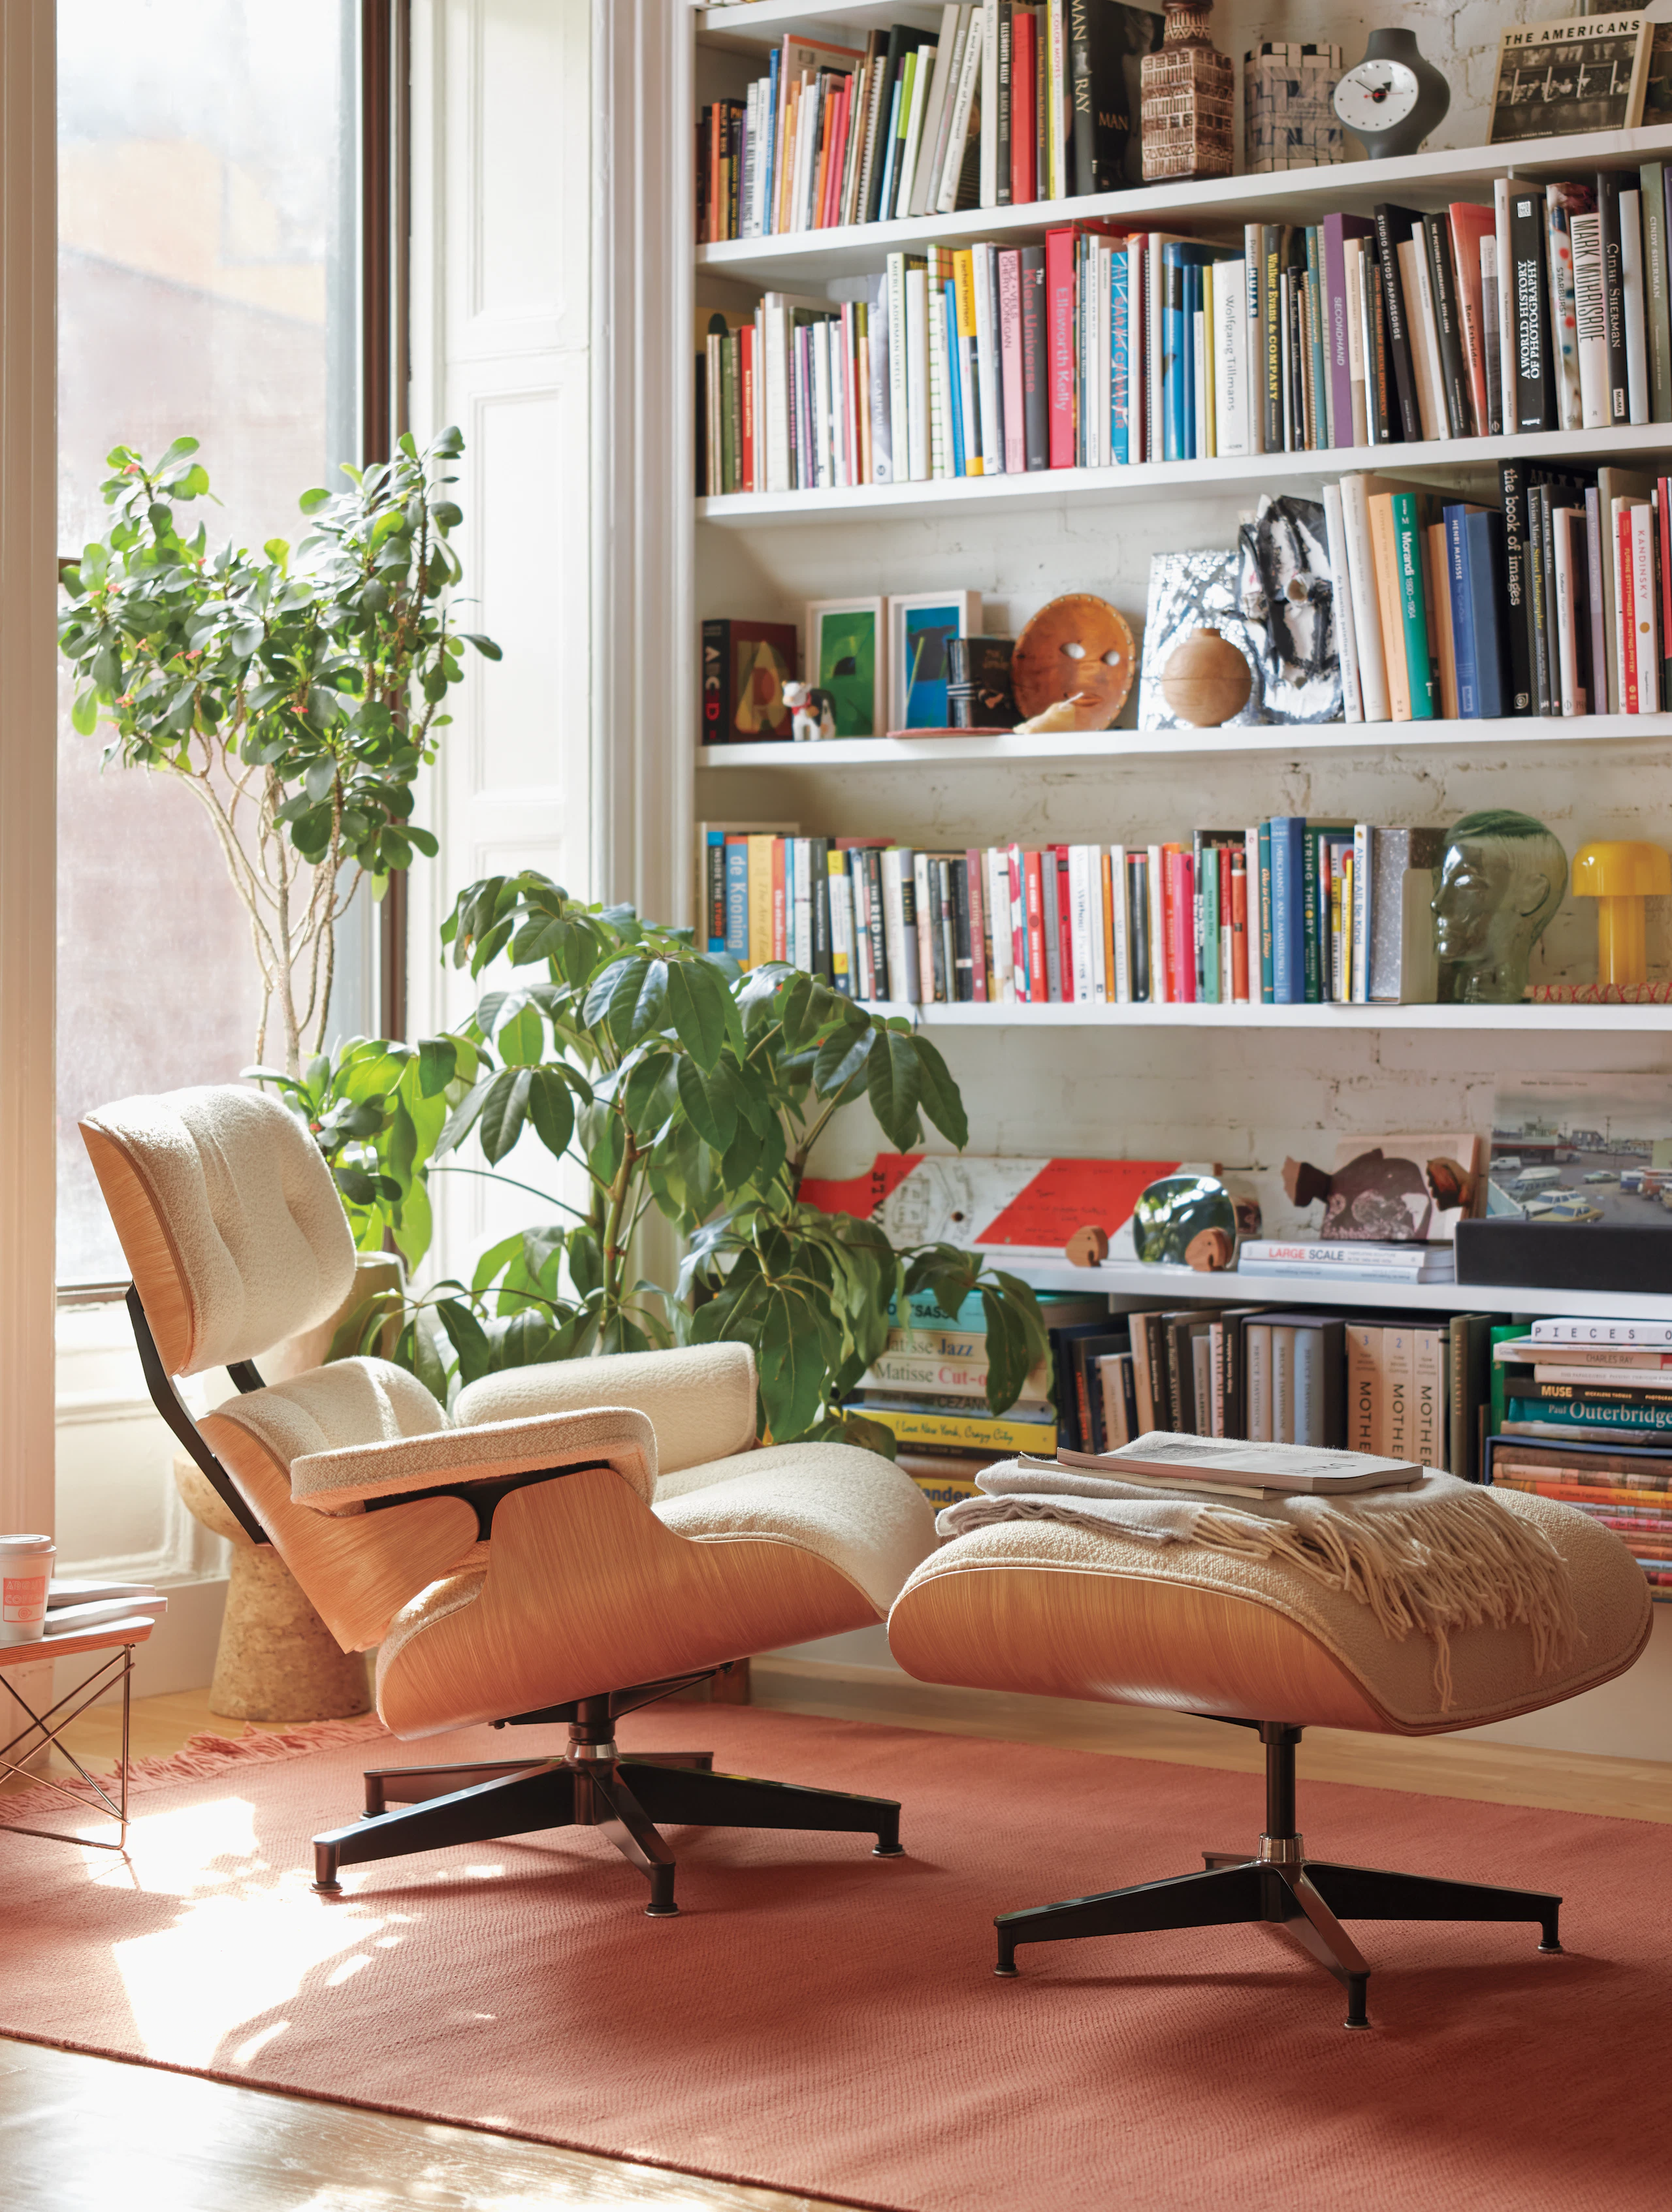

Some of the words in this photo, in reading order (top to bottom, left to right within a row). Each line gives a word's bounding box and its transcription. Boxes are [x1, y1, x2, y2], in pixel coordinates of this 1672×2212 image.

[1072, 0, 1087, 40] MAN
[1505, 32, 1534, 45] THE
[1541, 20, 1640, 41] AMERICANS
[956, 30, 965, 59] Donald
[1000, 22, 1010, 62] ELLSWORTH
[950, 60, 959, 84] Judd
[963, 66, 973, 89] Power
[1000, 64, 1010, 84] KELLY
[1000, 91, 1009, 112] BLACK
[1075, 78, 1090, 114] RAY
[955, 100, 966, 140] Placement
[999, 121, 1009, 142] WHITE
[1099, 112, 1129, 130] MAN
[1377, 214, 1387, 247] STUDIO
[1573, 219, 1601, 259] MARK
[1650, 216, 1660, 246] CINDY
[1248, 240, 1257, 265] Peter
[1382, 249, 1390, 261] 54
[961, 259, 970, 289] rachel
[1000, 256, 1010, 293] CHERYL
[1035, 268, 1044, 285] The
[1267, 253, 1278, 289] Walker
[1383, 261, 1392, 280] TOD
[1652, 249, 1661, 299] SHERMAN
[1010, 290, 1019, 319] VEILS
[1023, 269, 1037, 310] Klee
[1248, 268, 1259, 318] HUJAR
[1517, 261, 1529, 318] HISTORY
[1556, 266, 1567, 317] STARBURST
[1575, 261, 1606, 344] MORRISROE
[962, 290, 971, 327] harrison
[1003, 295, 1012, 349] DONEGAN
[1268, 291, 1279, 321] Evans
[1386, 281, 1400, 339] PAPAGEORGE
[1465, 304, 1473, 323] Roe
[1526, 259, 1539, 361] PHOTOGRAPHY
[1055, 287, 1069, 366] Ellsworth
[1114, 297, 1125, 349] SARAH
[1224, 295, 1236, 357] Wolfgang
[1269, 324, 1278, 334] &
[1334, 297, 1344, 366] SECONDHAND
[1024, 314, 1037, 393] Universe
[1519, 321, 1530, 372] WORLD
[1268, 336, 1279, 400] COMPANY
[1530, 364, 1540, 379] OF
[1055, 370, 1069, 411] Kelly
[1115, 352, 1124, 428] CROWNER
[1227, 358, 1237, 411] Tillmans
[1503, 469, 1518, 492] the
[1505, 496, 1520, 532] book
[1530, 496, 1540, 522] Vivian
[1453, 520, 1461, 545] HENRI
[1507, 536, 1522, 551] of
[1532, 524, 1542, 548] Maier
[1401, 532, 1413, 575] Morandi
[1454, 547, 1463, 580] MATISSE
[1532, 549, 1543, 573] Street
[1637, 530, 1648, 600] KANDINSKY
[1507, 555, 1522, 606] images
[1336, 586, 1346, 618] kooning
[1406, 578, 1416, 619] 1890-1964
[1533, 575, 1544, 630] Photographer
[1339, 621, 1349, 656] paintings
[714, 848, 722, 880] INSIDE
[730, 855, 747, 876] de
[1276, 844, 1285, 897] MERCHANTS
[1304, 833, 1314, 881] STRING
[1355, 847, 1364, 882] Above
[714, 882, 722, 901] THE
[775, 890, 784, 906] the
[714, 902, 722, 937] STUDIO
[727, 883, 747, 949] Kooning
[775, 908, 784, 940] studio
[870, 905, 881, 934] RED
[969, 890, 981, 927] staring
[1077, 890, 1087, 932] Without
[1208, 910, 1214, 920] to
[1262, 897, 1271, 930] Common
[1355, 905, 1363, 918] Be
[1263, 931, 1272, 959] Things
[1355, 920, 1363, 945] Kind
[873, 936, 882, 970] PARTS
[974, 944, 982, 965] sun
[1277, 922, 1285, 980] MASTERPIECES
[1268, 1247, 1305, 1260] LARGE
[1308, 1249, 1344, 1261] SCALE
[938, 1338, 973, 1356] Jazz
[1363, 1335, 1369, 1346] 3
[1396, 1338, 1402, 1349] 2
[1535, 1327, 1635, 1339] PIECES
[876, 1362, 933, 1383] Matisse
[1586, 1353, 1617, 1364] CHARLES
[1620, 1354, 1633, 1364] RAY
[1541, 1385, 1573, 1398] MUSE
[1549, 1404, 1567, 1415] Paul
[1569, 1402, 1672, 1428] Outerbridge
[901, 1421, 918, 1433] Love
[921, 1422, 938, 1435] New
[964, 1426, 991, 1444] Crazy
[993, 1428, 1014, 1445] City
[6, 1579, 43, 1591] ABOUT
